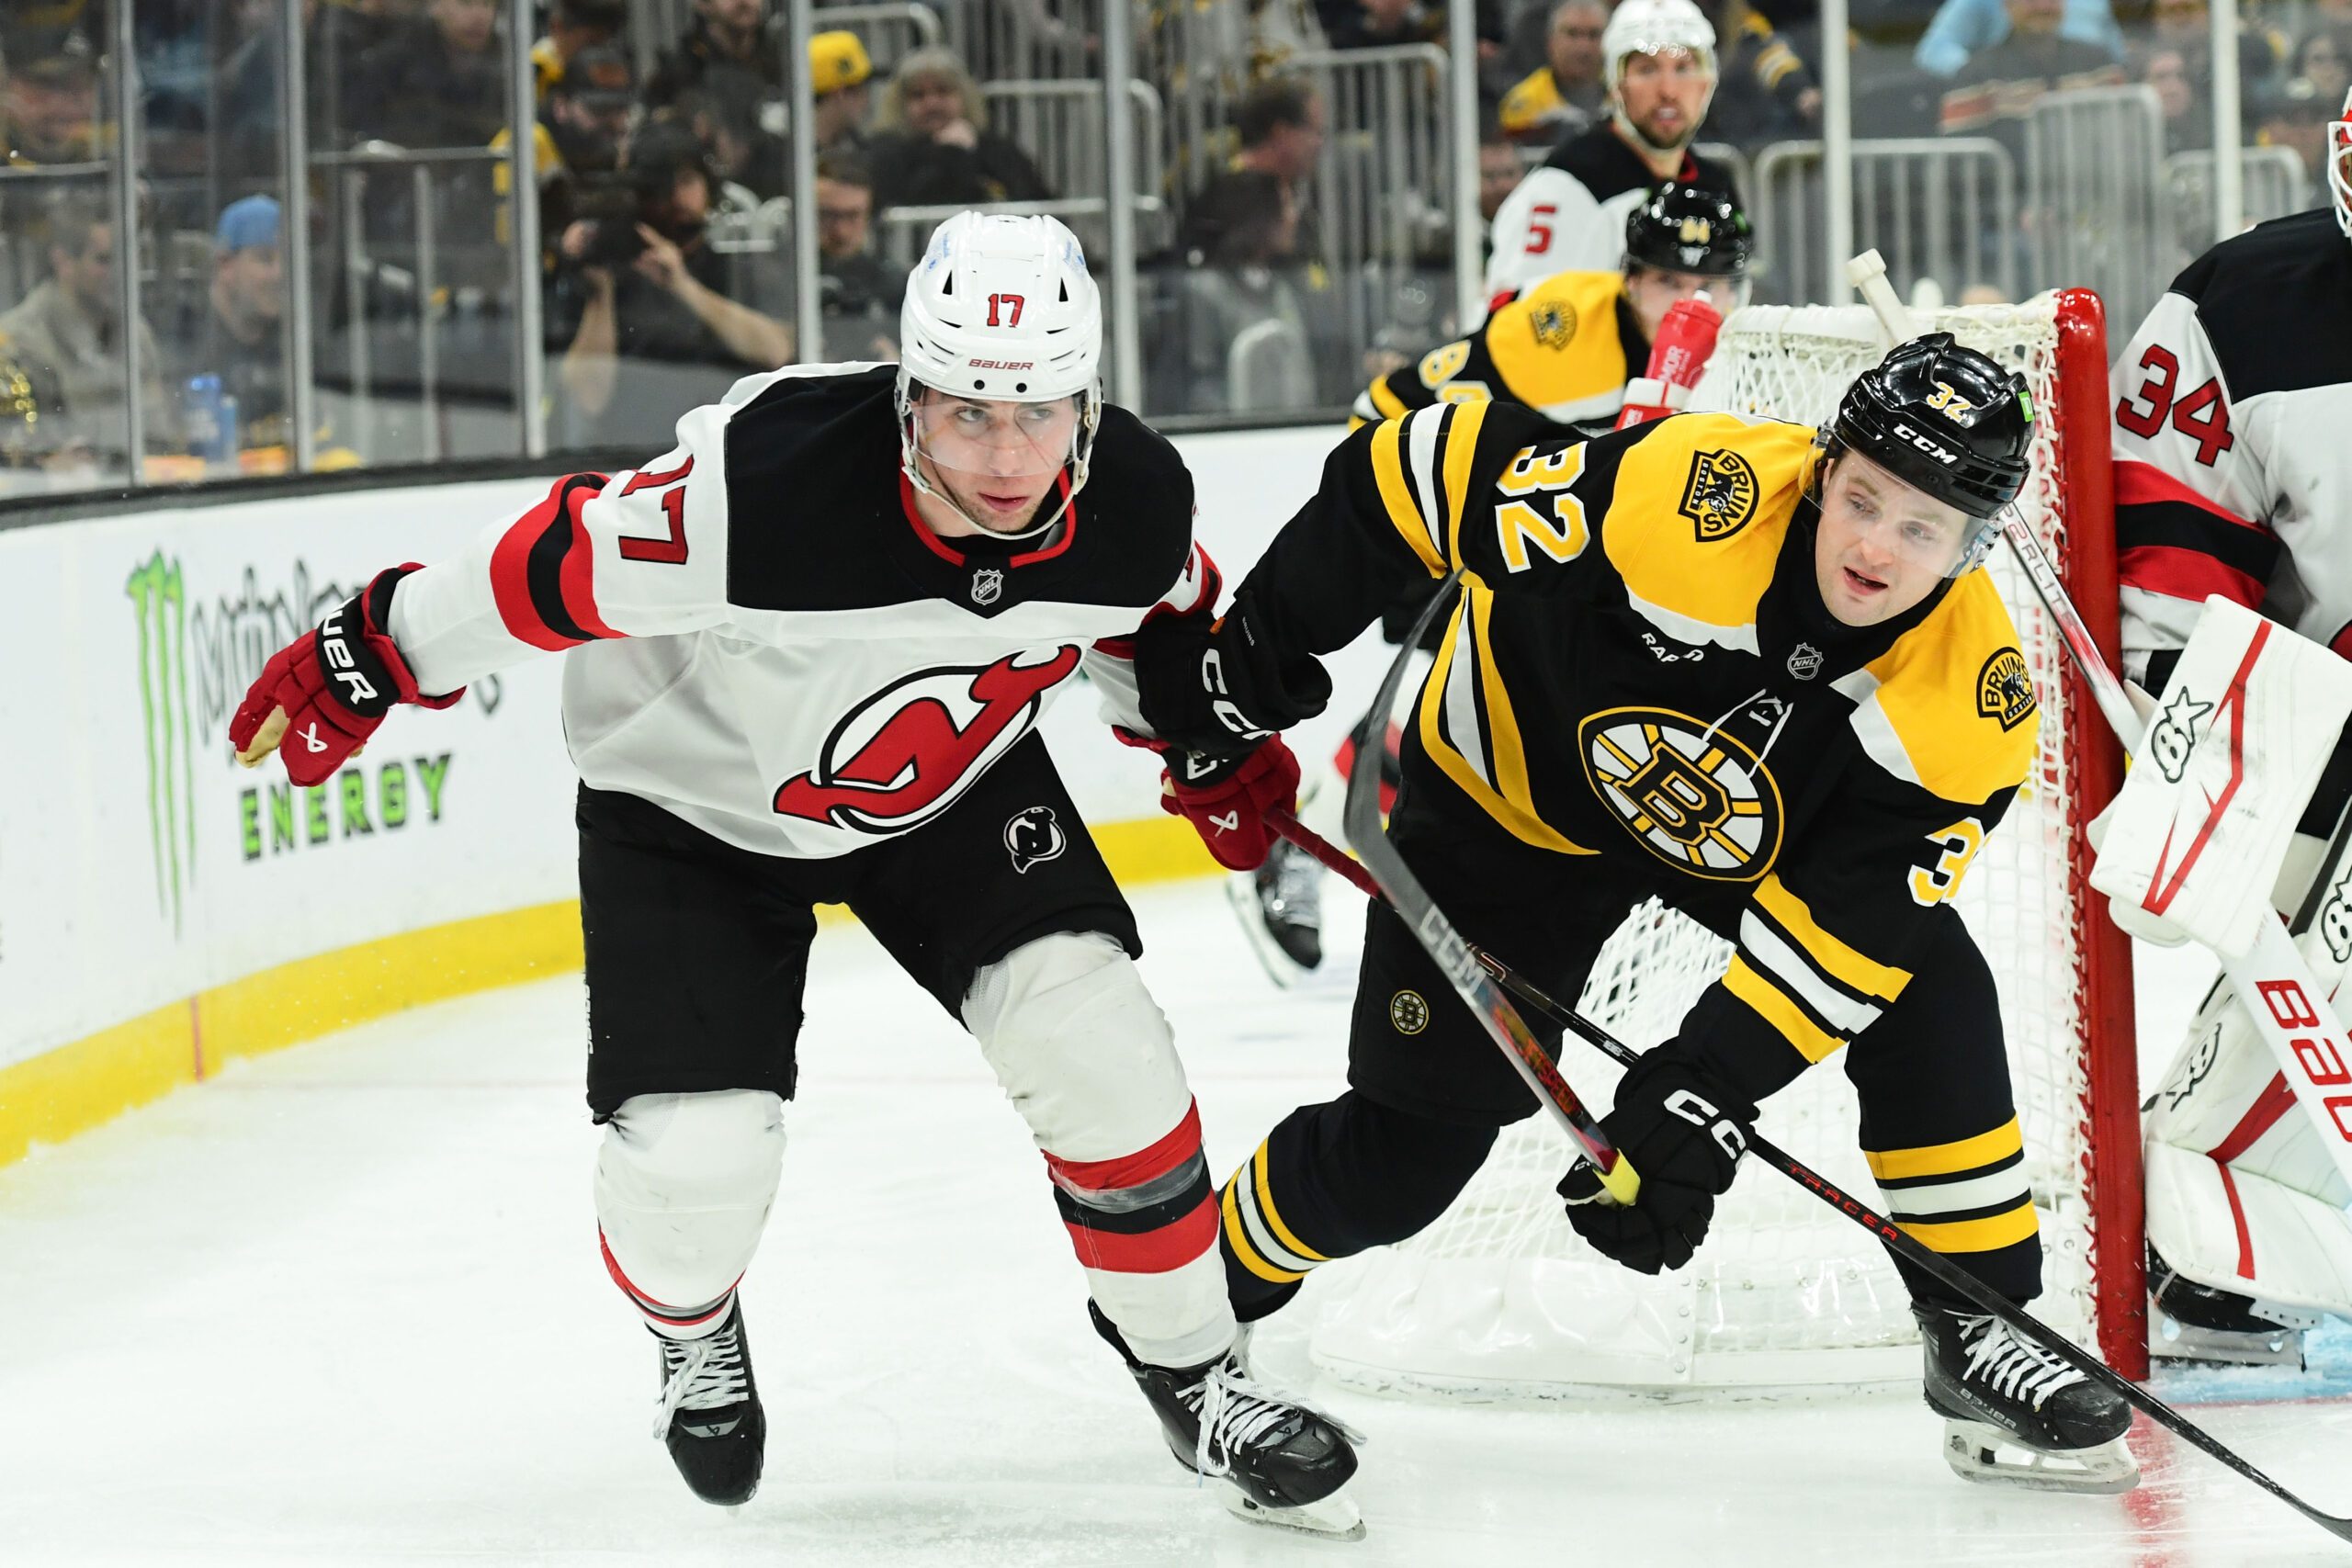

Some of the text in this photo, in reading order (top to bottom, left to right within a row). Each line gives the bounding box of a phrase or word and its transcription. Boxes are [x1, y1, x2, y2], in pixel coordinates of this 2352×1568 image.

[1524, 204, 1557, 254] 5
[987, 293, 1024, 328] 17
[968, 358, 1034, 371] BAUER
[1926, 381, 1971, 423] 32
[2116, 344, 2234, 468] 34
[1893, 423, 1958, 464] CCM
[1495, 440, 1591, 573] 32
[1691, 461, 1709, 505] BOSTON
[1702, 455, 1750, 533] BRUINS
[618, 453, 695, 565] 17
[978, 579, 998, 597] NHL
[1792, 658, 1815, 668] NHL
[1984, 656, 2030, 707] BRUINS
[2007, 694, 2032, 717] BOSTON
[240, 751, 452, 863] ENERGY
[1907, 816, 1990, 908] 3
[1418, 902, 1487, 997] CCM
[1785, 1161, 1898, 1242] TRACER
[1959, 1387, 2017, 1429] BAUER
